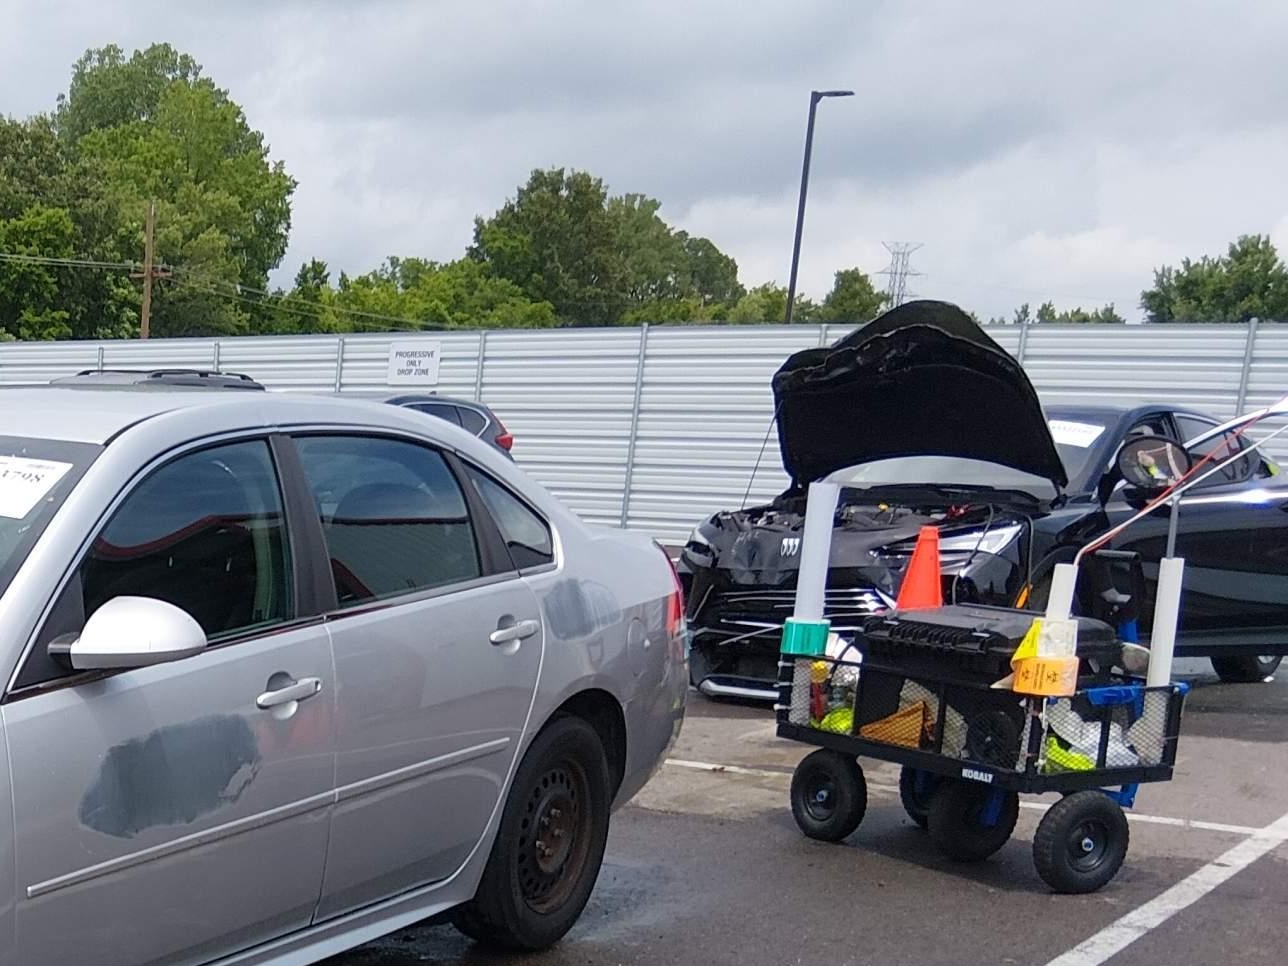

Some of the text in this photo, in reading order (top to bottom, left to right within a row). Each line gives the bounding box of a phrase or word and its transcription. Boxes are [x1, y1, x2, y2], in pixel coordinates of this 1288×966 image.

[395, 350, 434, 359] PROGRESSIVE
[406, 359, 422, 367] ONLY
[962, 768, 994, 783] KOBALT
